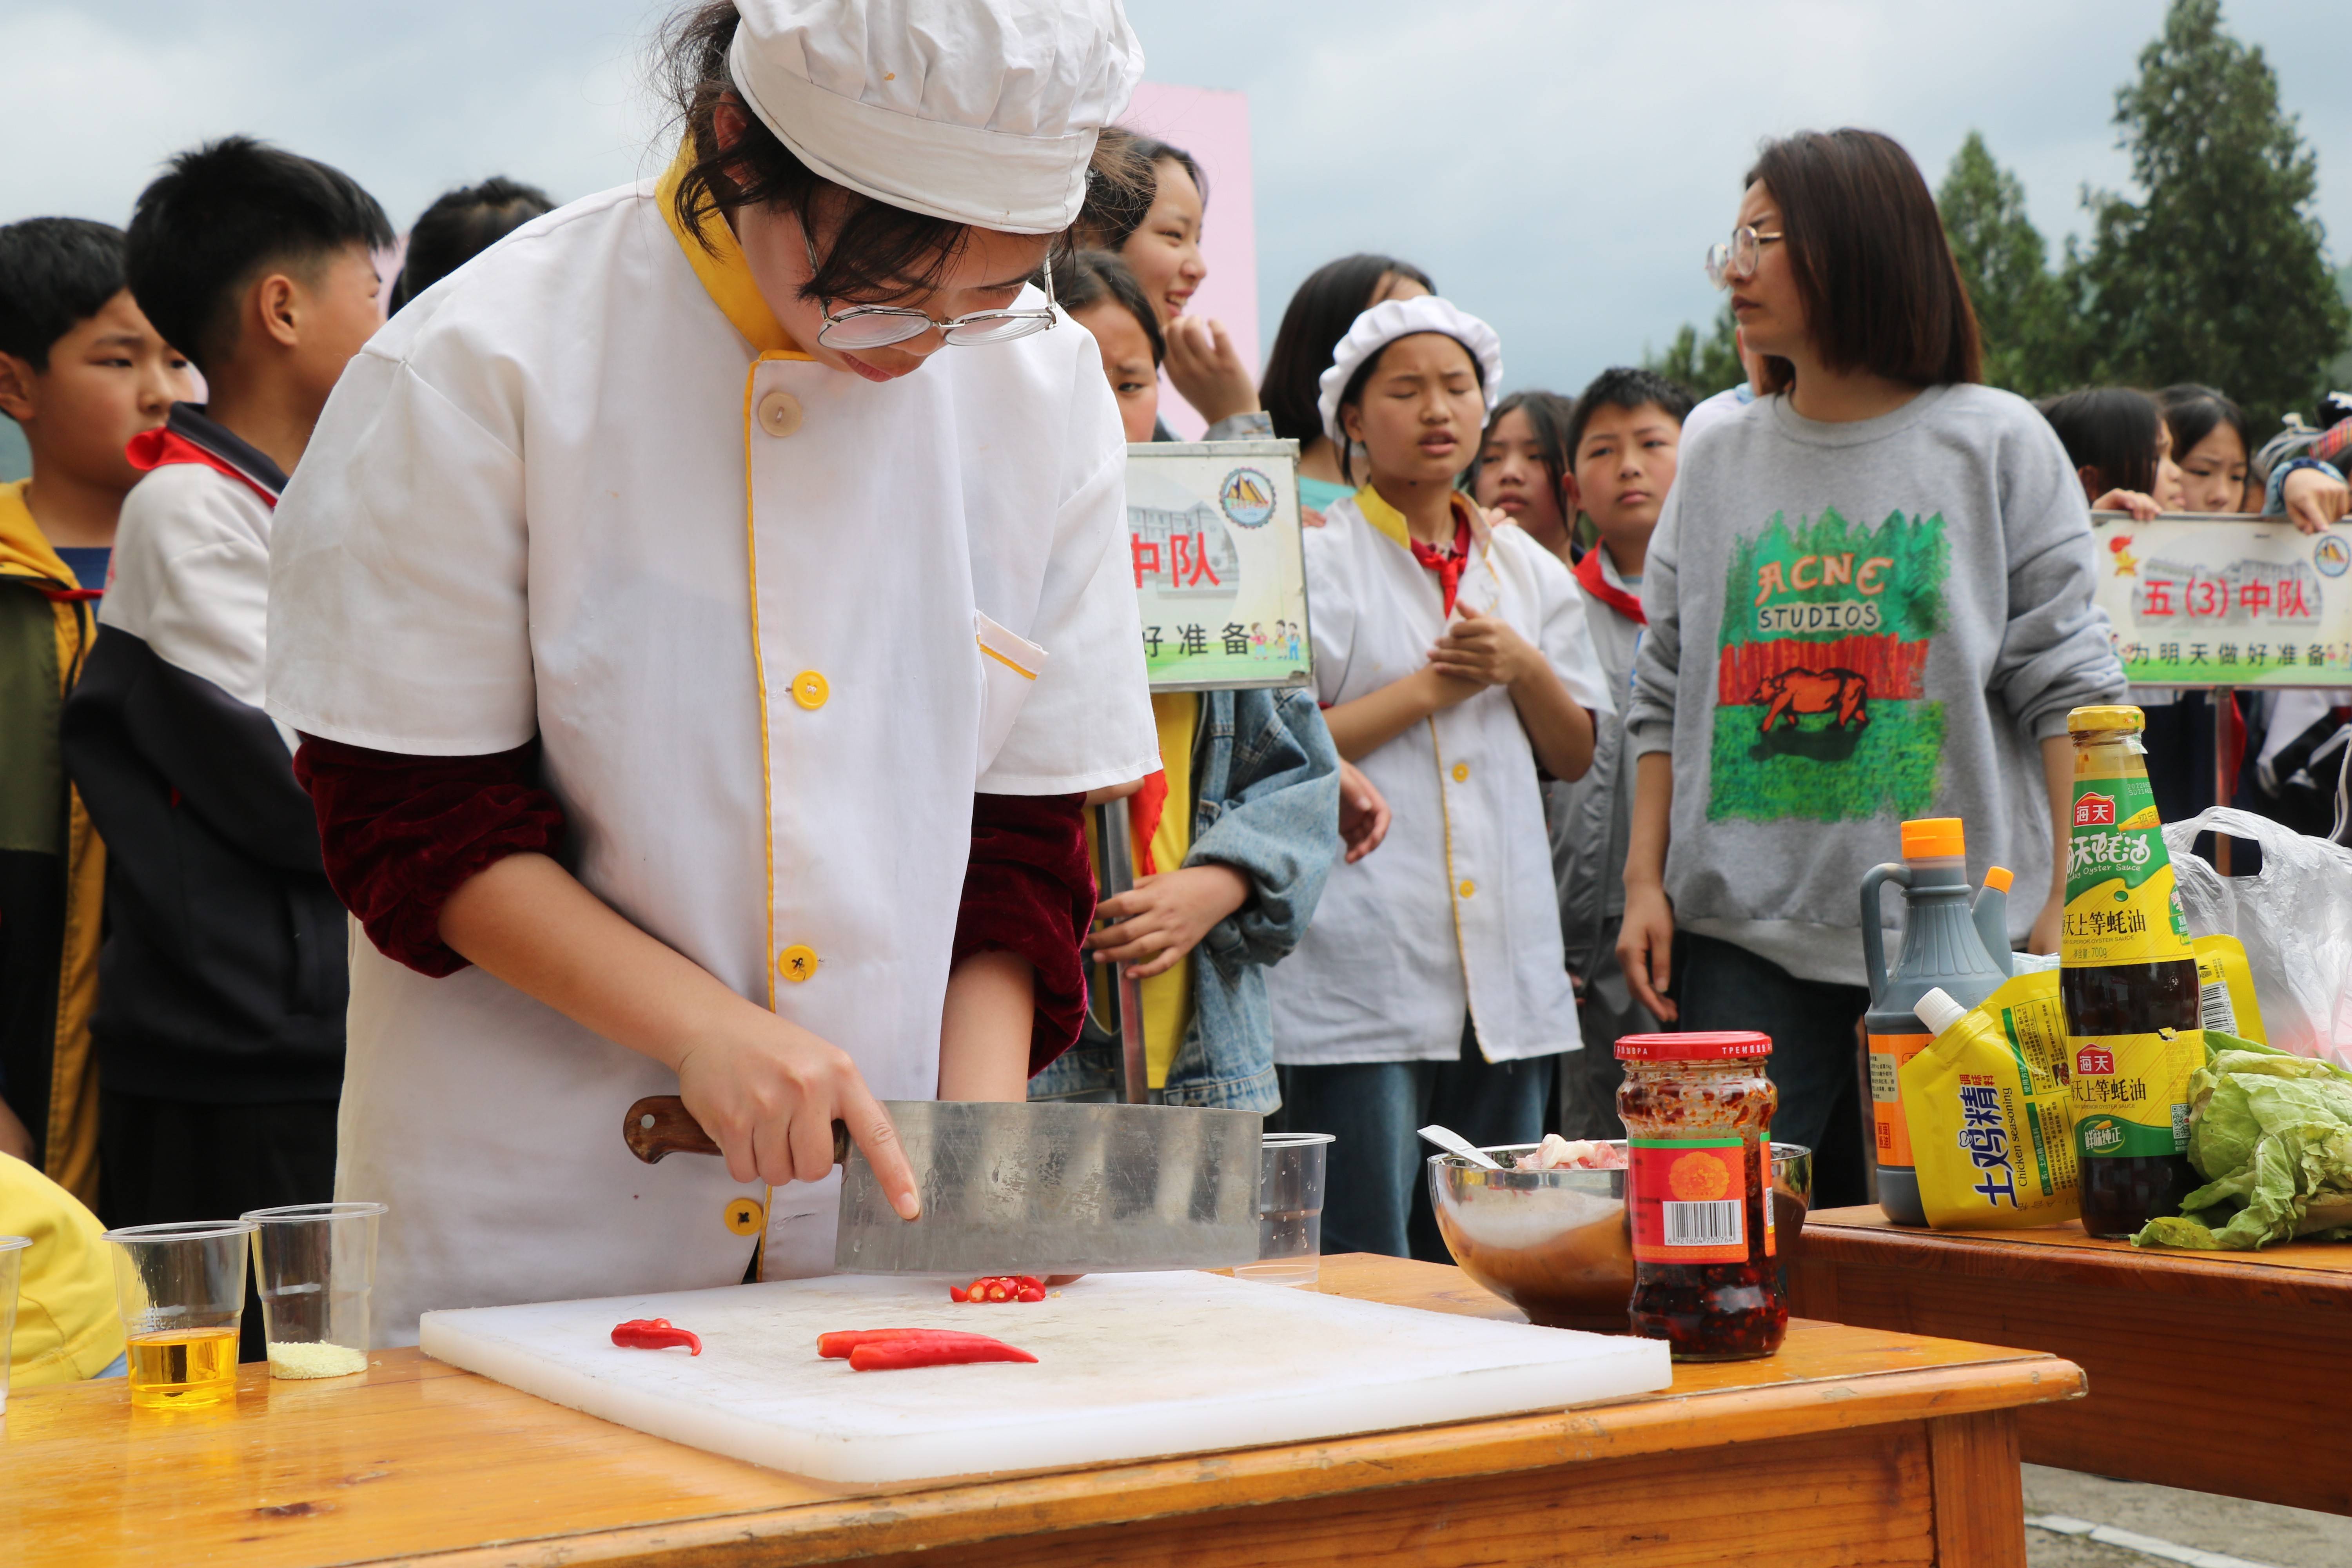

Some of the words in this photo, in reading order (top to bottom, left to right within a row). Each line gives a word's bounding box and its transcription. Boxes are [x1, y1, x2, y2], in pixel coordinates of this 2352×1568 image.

[1131, 532, 1221, 588] 中队
[1755, 552, 1894, 607] ACNE
[2141, 577, 2310, 618] 五(3)中队
[1760, 603, 1878, 629] STUDIOS
[2131, 641, 2327, 668] 为明天做好准备
[2076, 805, 2109, 822] 海天
[2083, 864, 2111, 875] Oyster
[2062, 909, 2146, 937] 天上等蚝油
[2080, 1055, 2109, 1072] 海天
[1959, 1074, 1995, 1085] 调味料
[2018, 1065, 2031, 1093] 使用方法
[2003, 1087, 2019, 1142] seasoning
[1960, 1085, 2018, 1208] 土鸡精
[2085, 1126, 2122, 1150] 鲜味纯正
[2014, 1145, 2027, 1187] Chicken
